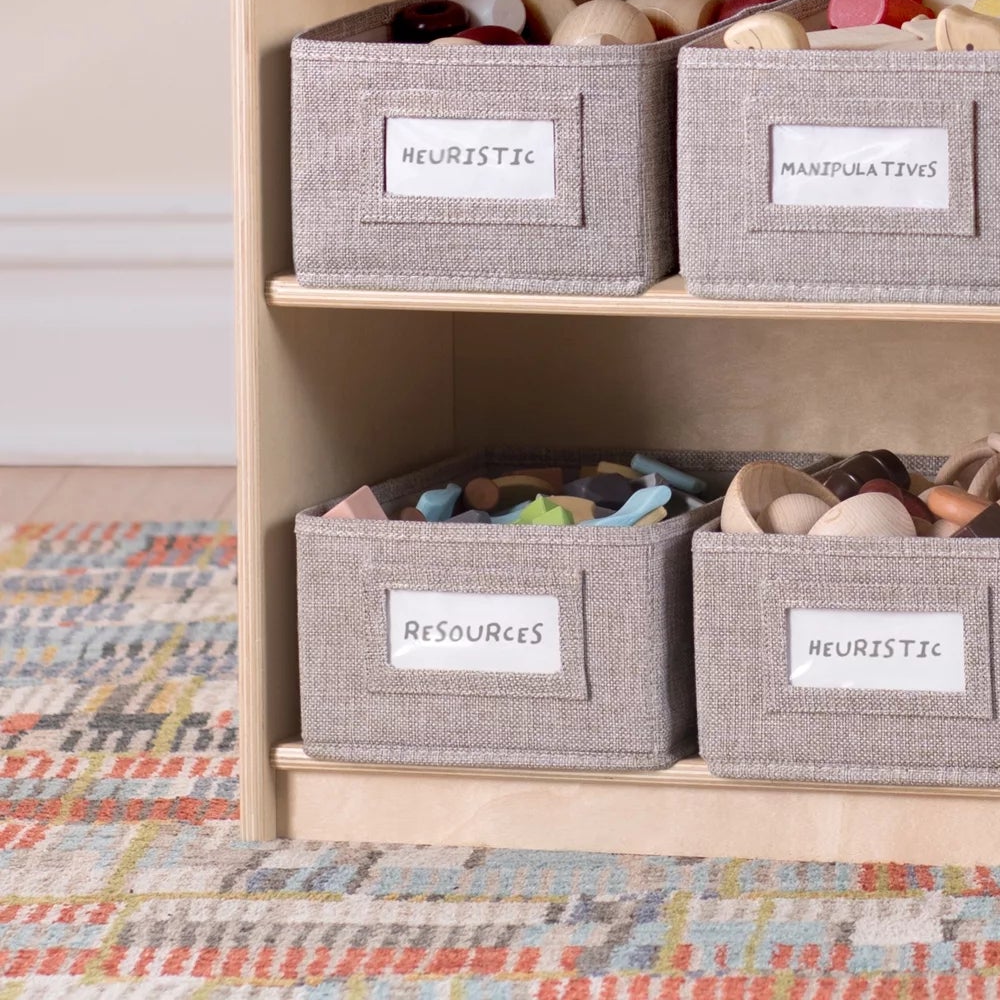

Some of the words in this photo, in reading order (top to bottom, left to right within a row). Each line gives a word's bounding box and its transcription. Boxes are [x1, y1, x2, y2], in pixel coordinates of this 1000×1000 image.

[402, 146, 535, 166] HEURISTIC
[780, 160, 938, 178] MANIPULATIVES
[404, 620, 544, 645] RESOURCES
[808, 638, 942, 659] HEURISTIC
